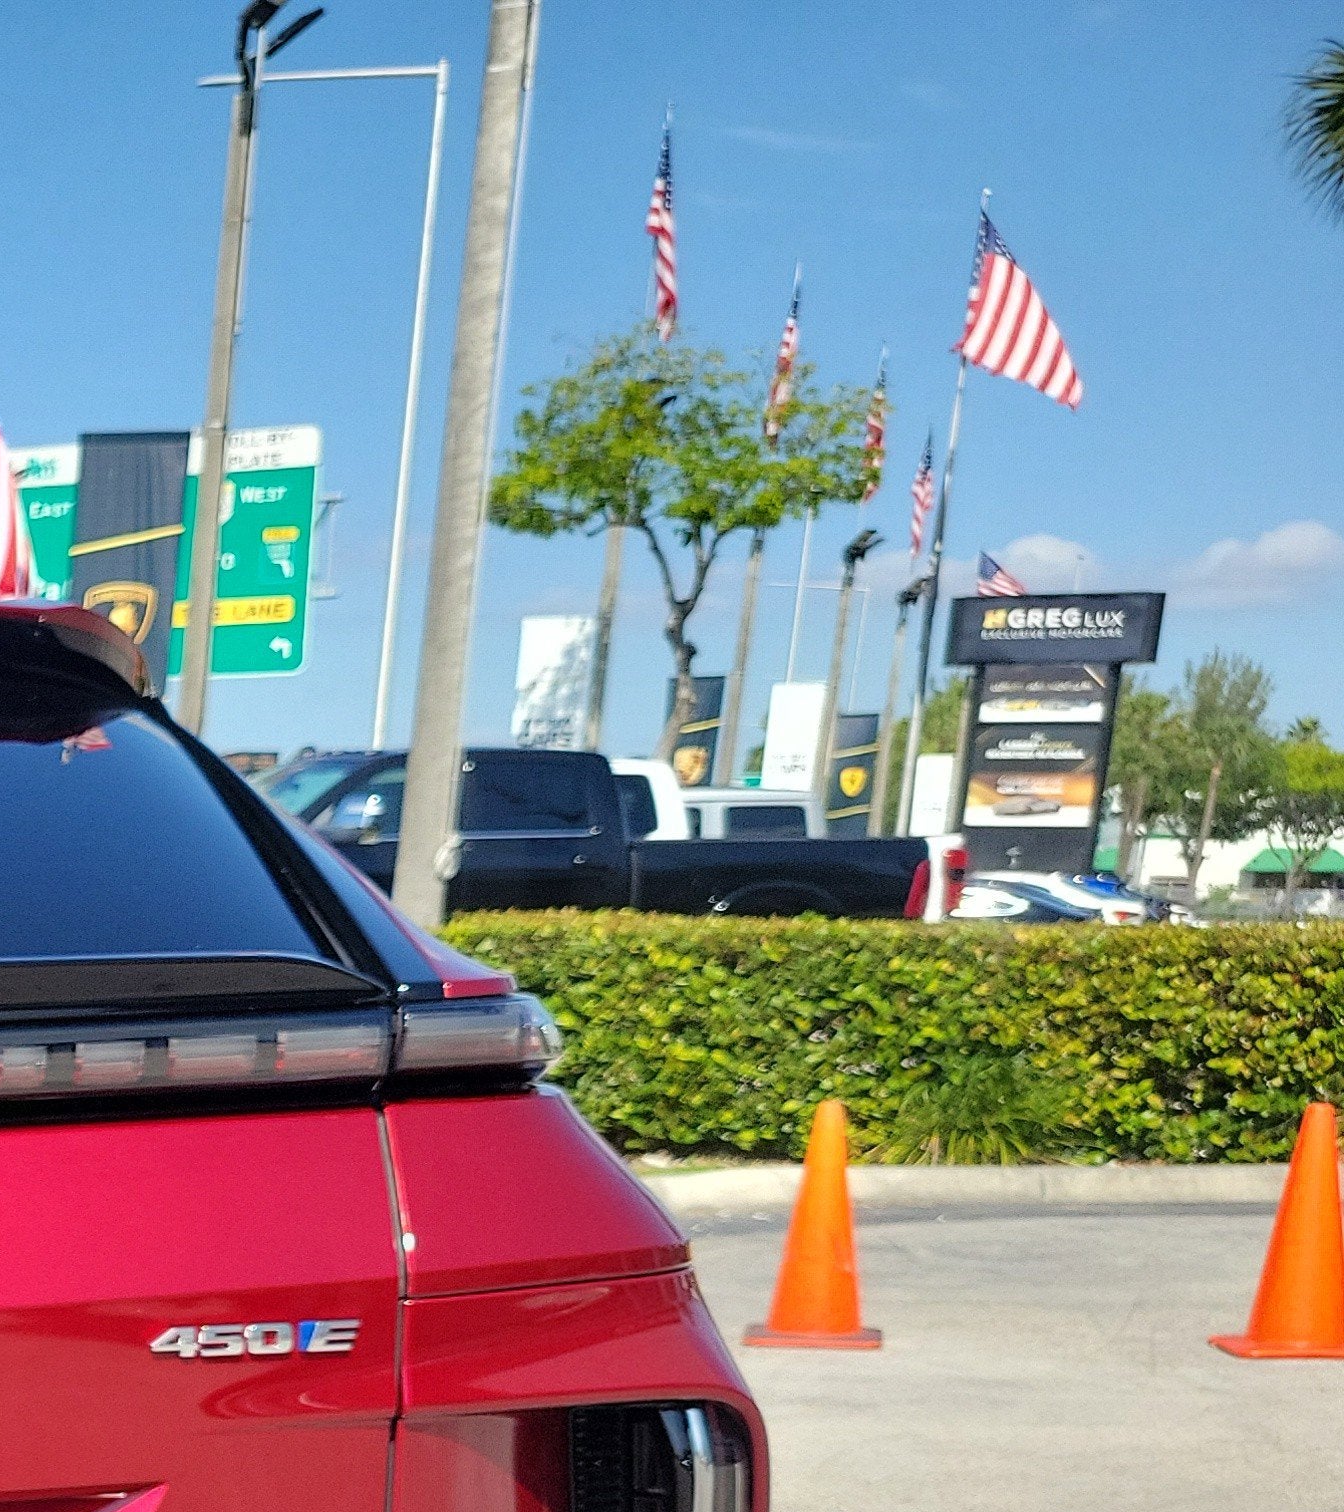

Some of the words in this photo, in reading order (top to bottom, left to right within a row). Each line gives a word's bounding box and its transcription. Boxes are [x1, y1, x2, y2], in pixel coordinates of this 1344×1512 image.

[239, 485, 288, 504] WEST
[29, 501, 76, 520] EAST
[232, 602, 287, 622] LANE
